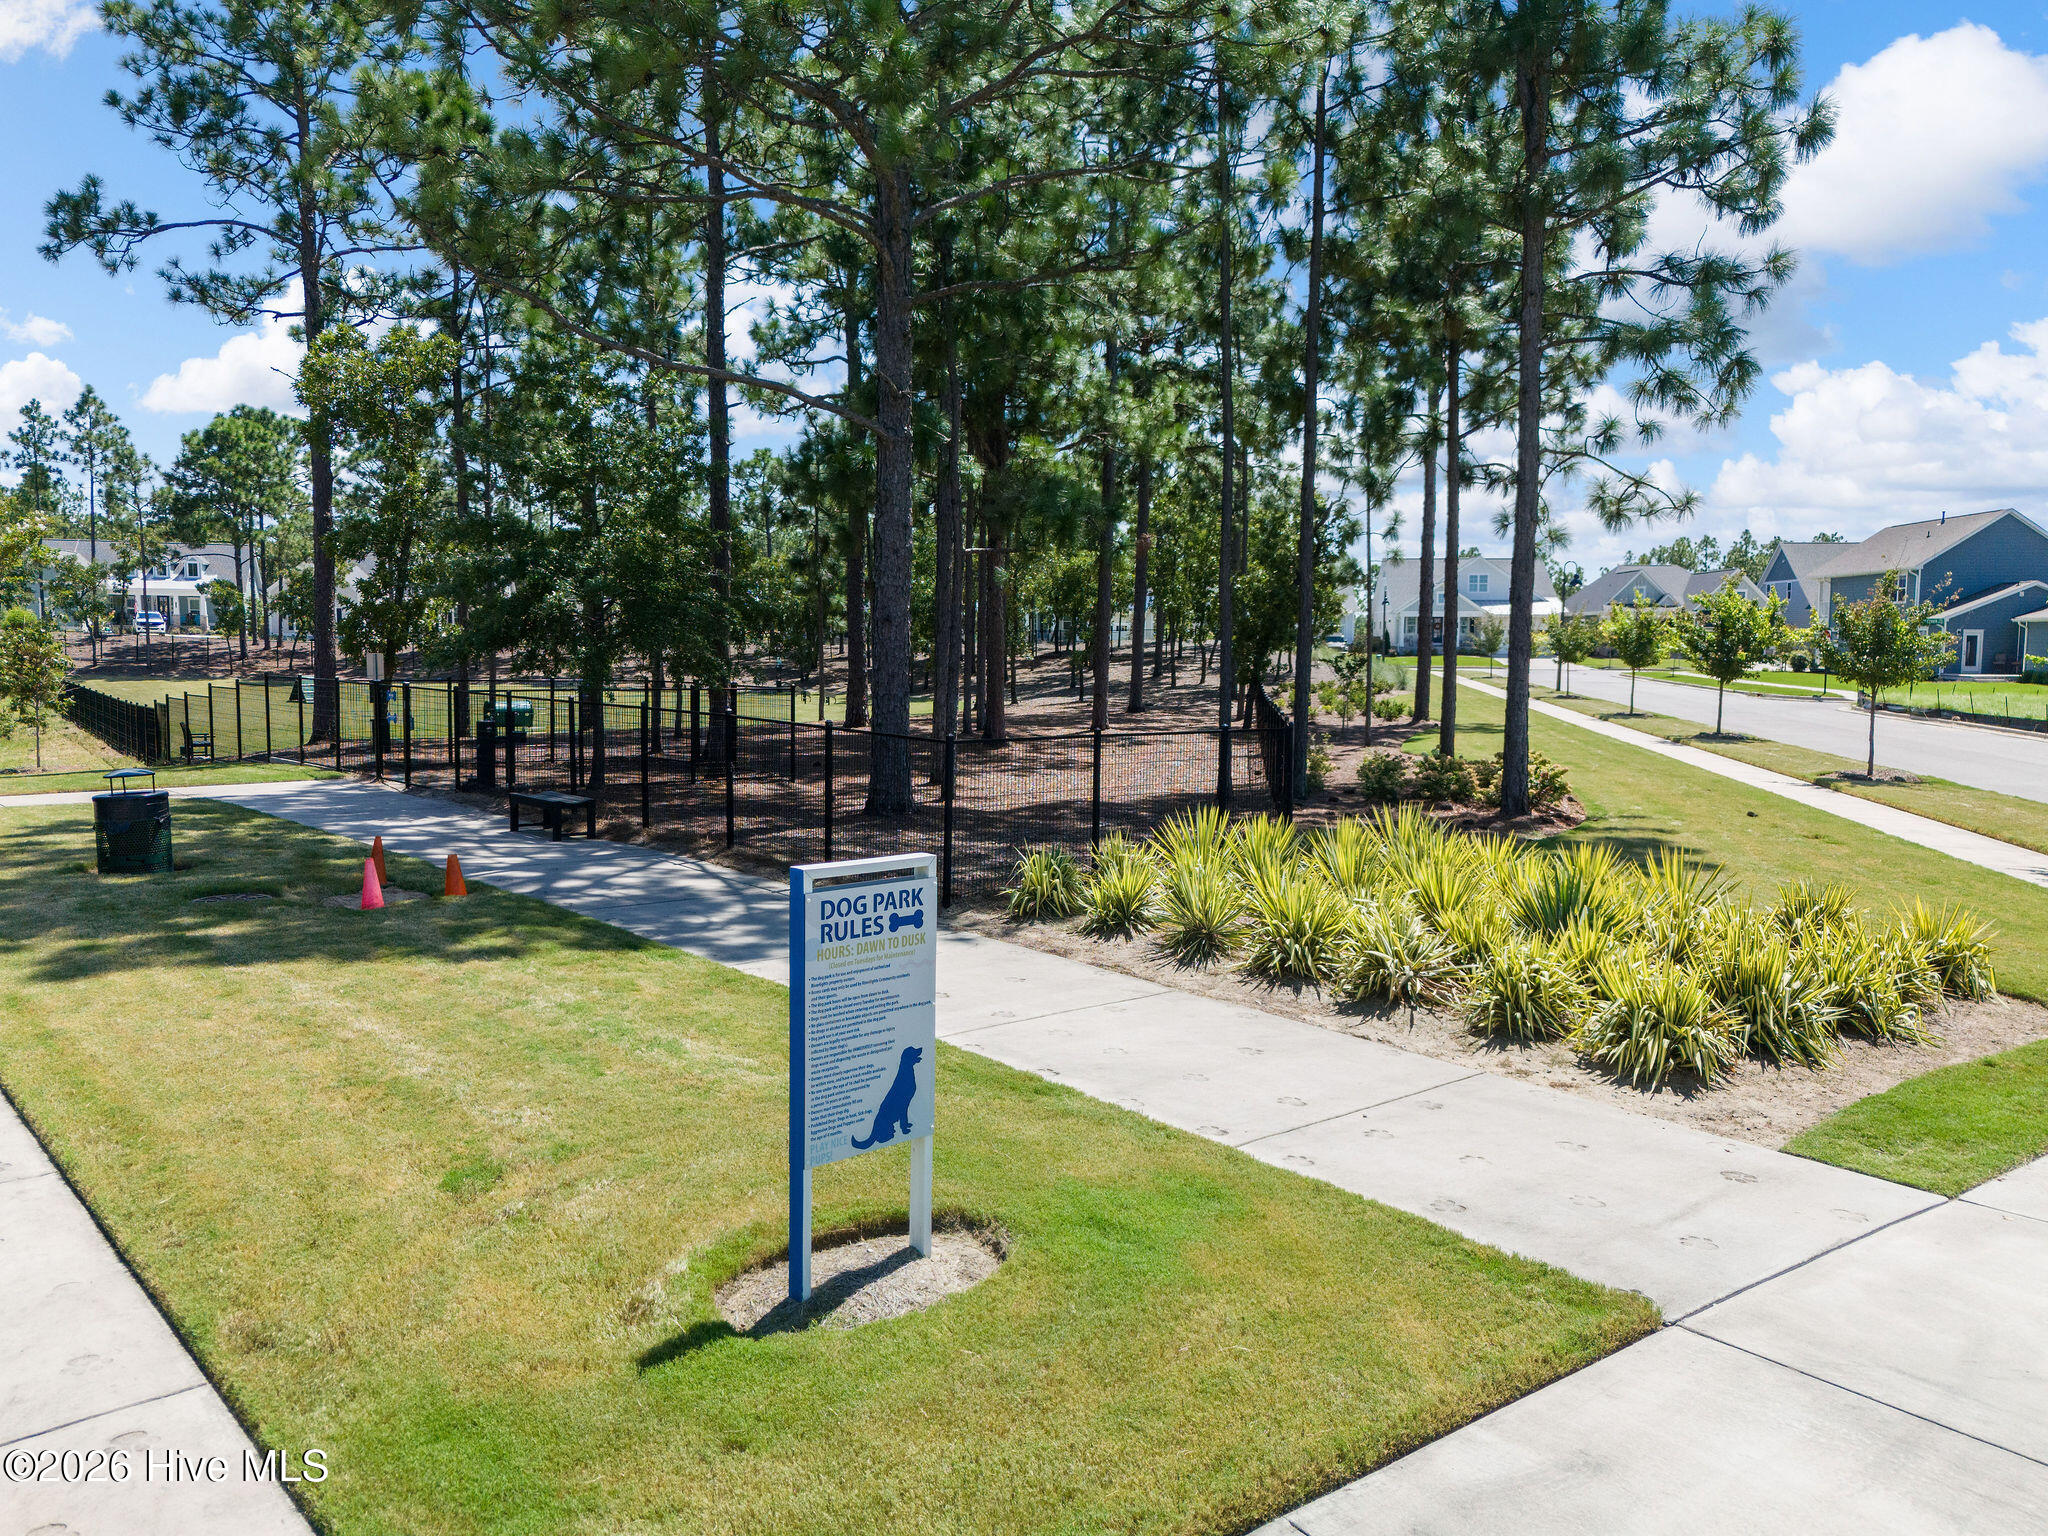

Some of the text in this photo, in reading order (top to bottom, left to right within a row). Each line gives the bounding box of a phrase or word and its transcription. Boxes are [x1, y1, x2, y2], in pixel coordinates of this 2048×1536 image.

[820, 888, 924, 920] DOG PARK
[820, 916, 884, 944] RULES
[816, 932, 926, 962] HOURS: DAWN TO DUSK
[828, 960, 846, 970] (Closed
[854, 955, 875, 966] Tuesdays
[884, 948, 915, 960] Maintenance)
[810, 1134, 847, 1154] PLAY NICE
[810, 1151, 832, 1166] PUPS!
